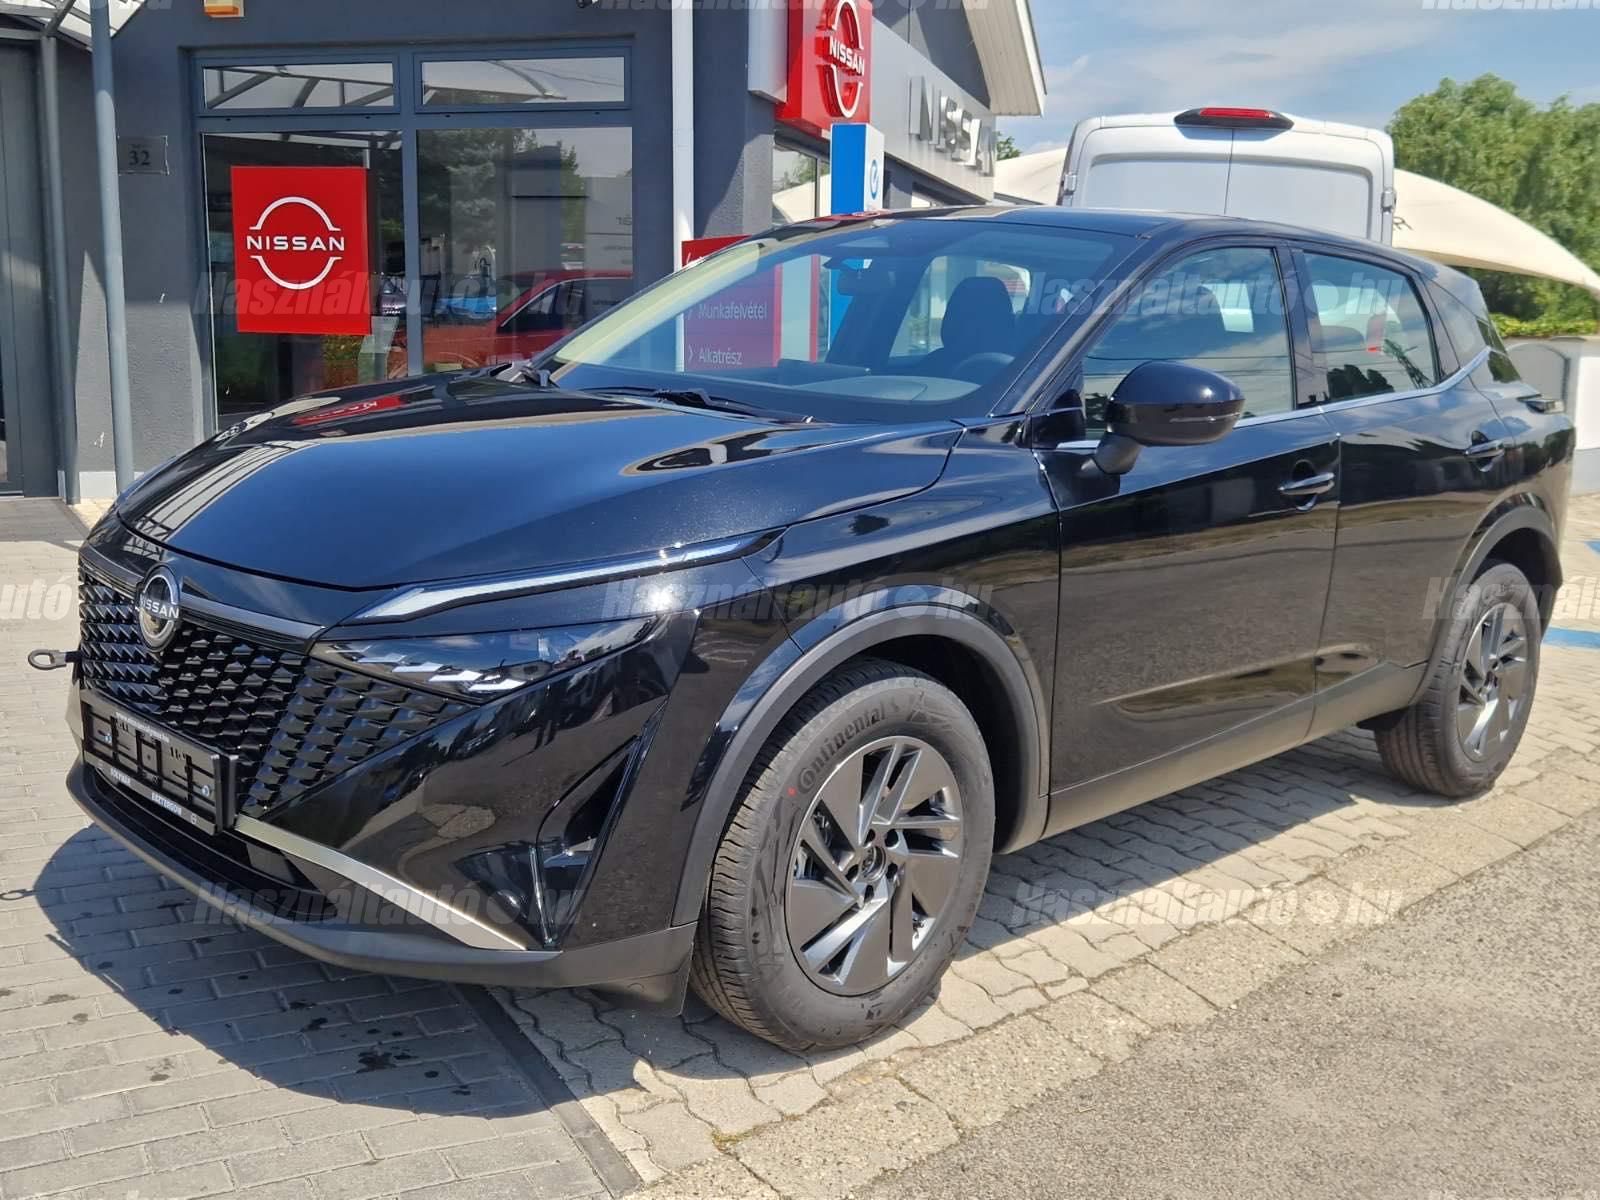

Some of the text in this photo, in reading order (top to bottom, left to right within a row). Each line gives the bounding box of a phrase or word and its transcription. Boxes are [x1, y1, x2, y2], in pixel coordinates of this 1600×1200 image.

[829, 39, 865, 76] NISSAN
[128, 150, 151, 166] 32
[246, 235, 345, 251] NISSAN
[698, 301, 768, 320] Munkafelvétel
[699, 346, 743, 366] Alkatrész
[797, 702, 886, 794] Continental
